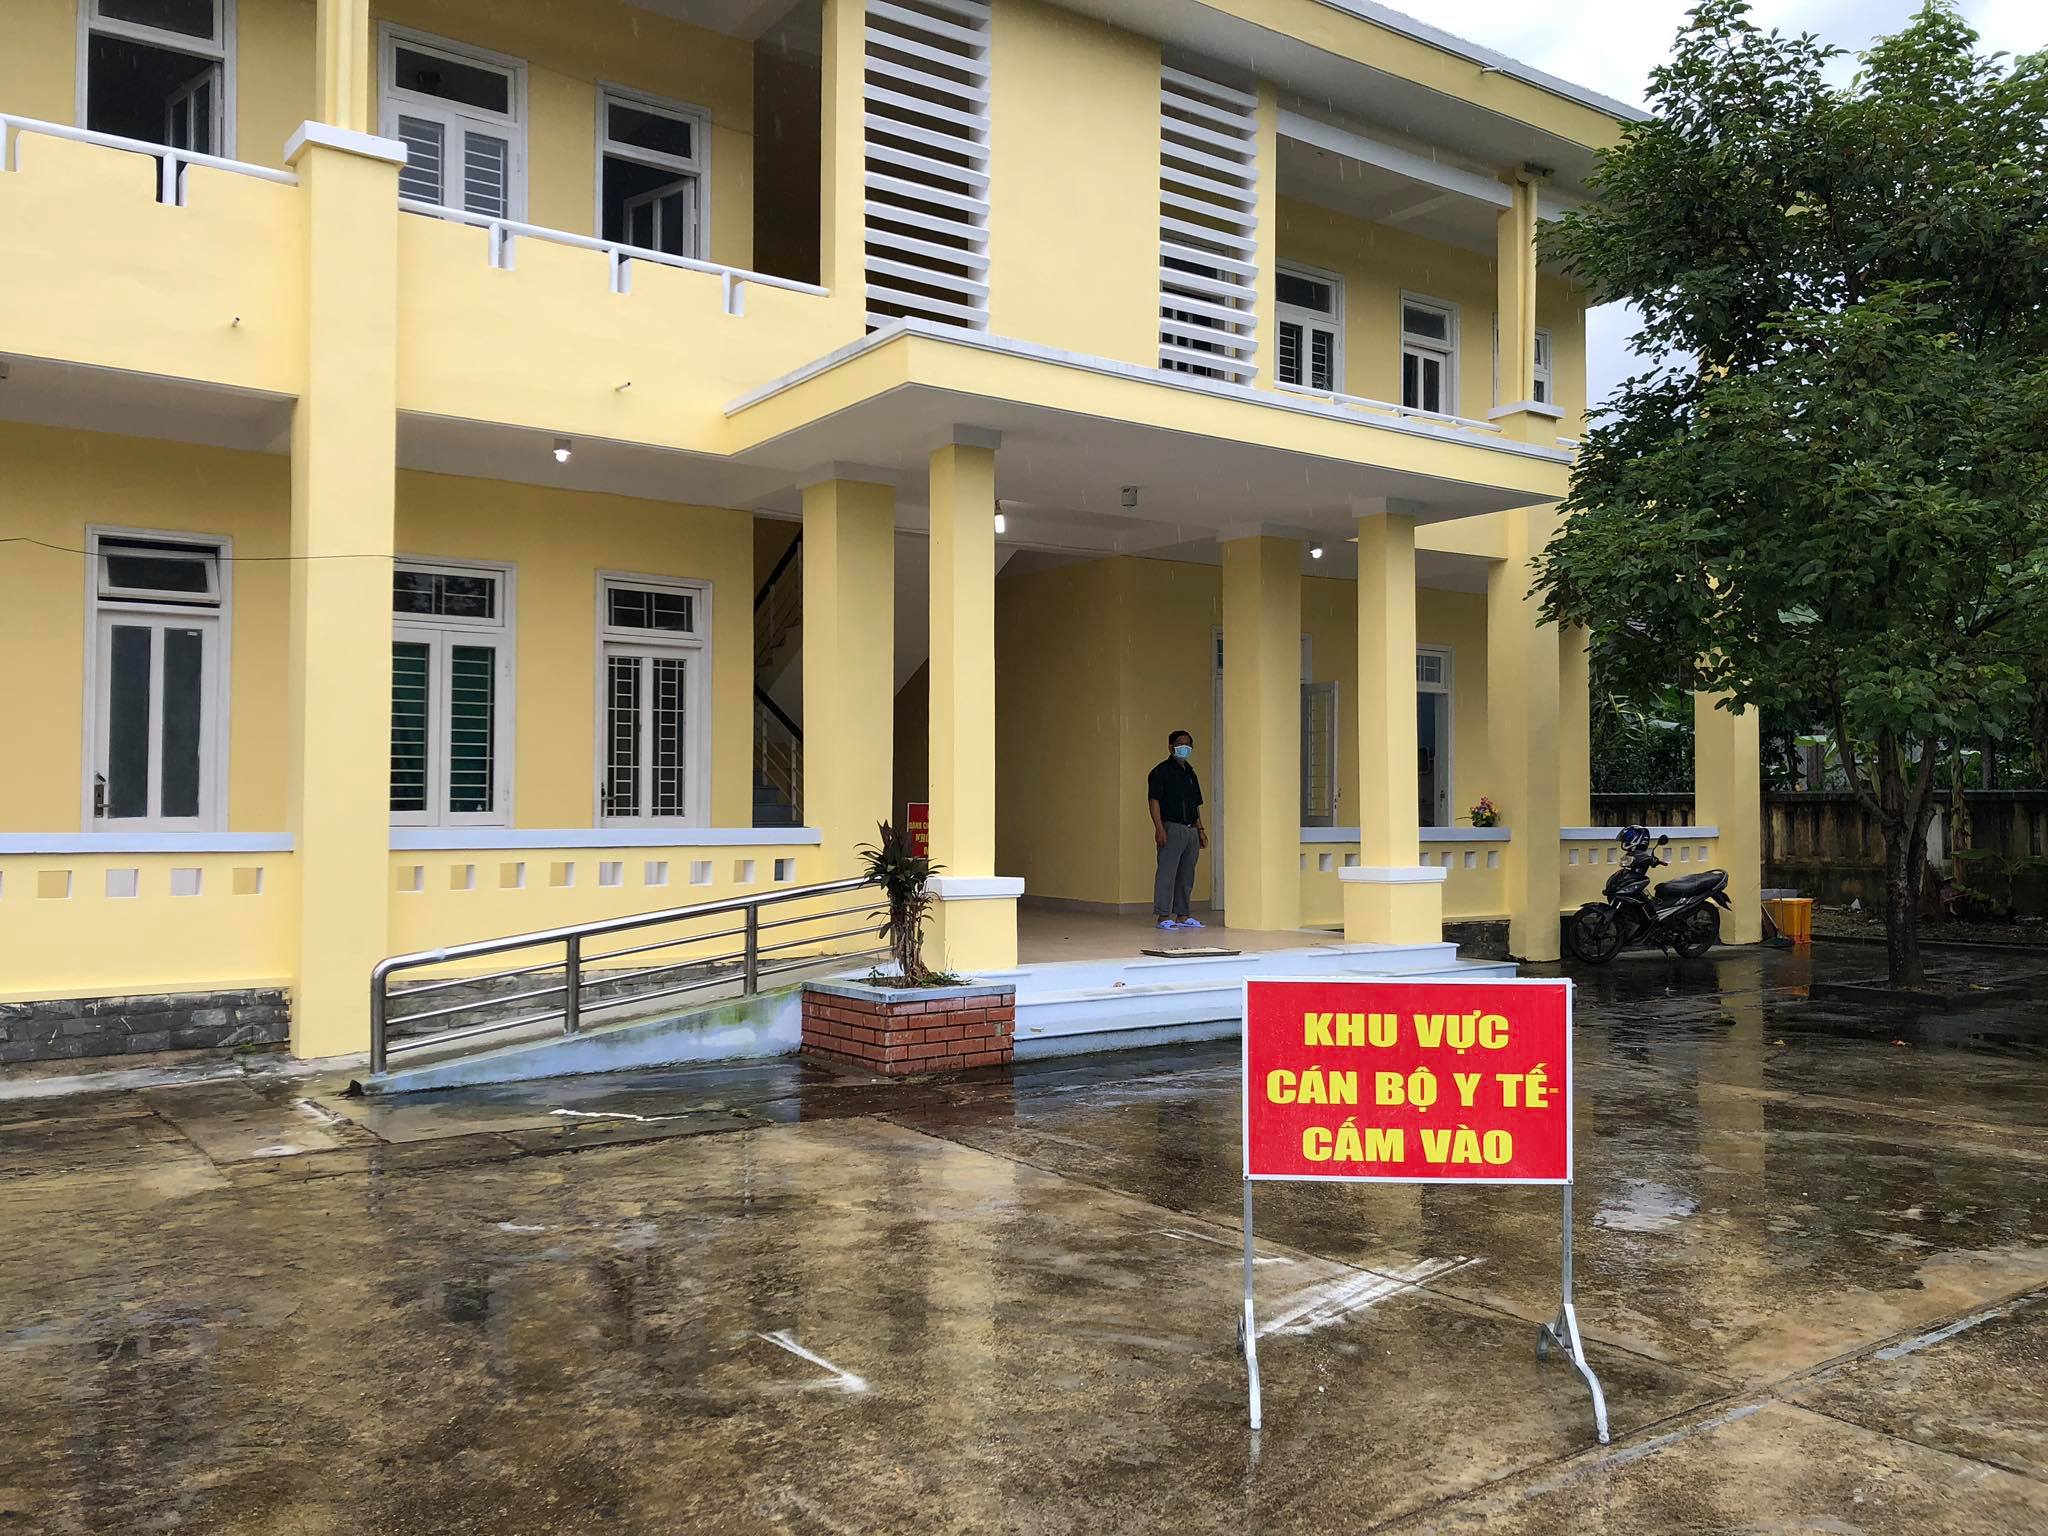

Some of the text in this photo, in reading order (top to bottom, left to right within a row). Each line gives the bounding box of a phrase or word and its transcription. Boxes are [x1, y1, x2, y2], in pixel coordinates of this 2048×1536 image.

[1304, 1009, 1509, 1054] KHU VỰC
[1266, 1062, 1549, 1112] CÁN BỘ Y TẾ
[1302, 1116, 1512, 1165] CẤM VÀO
